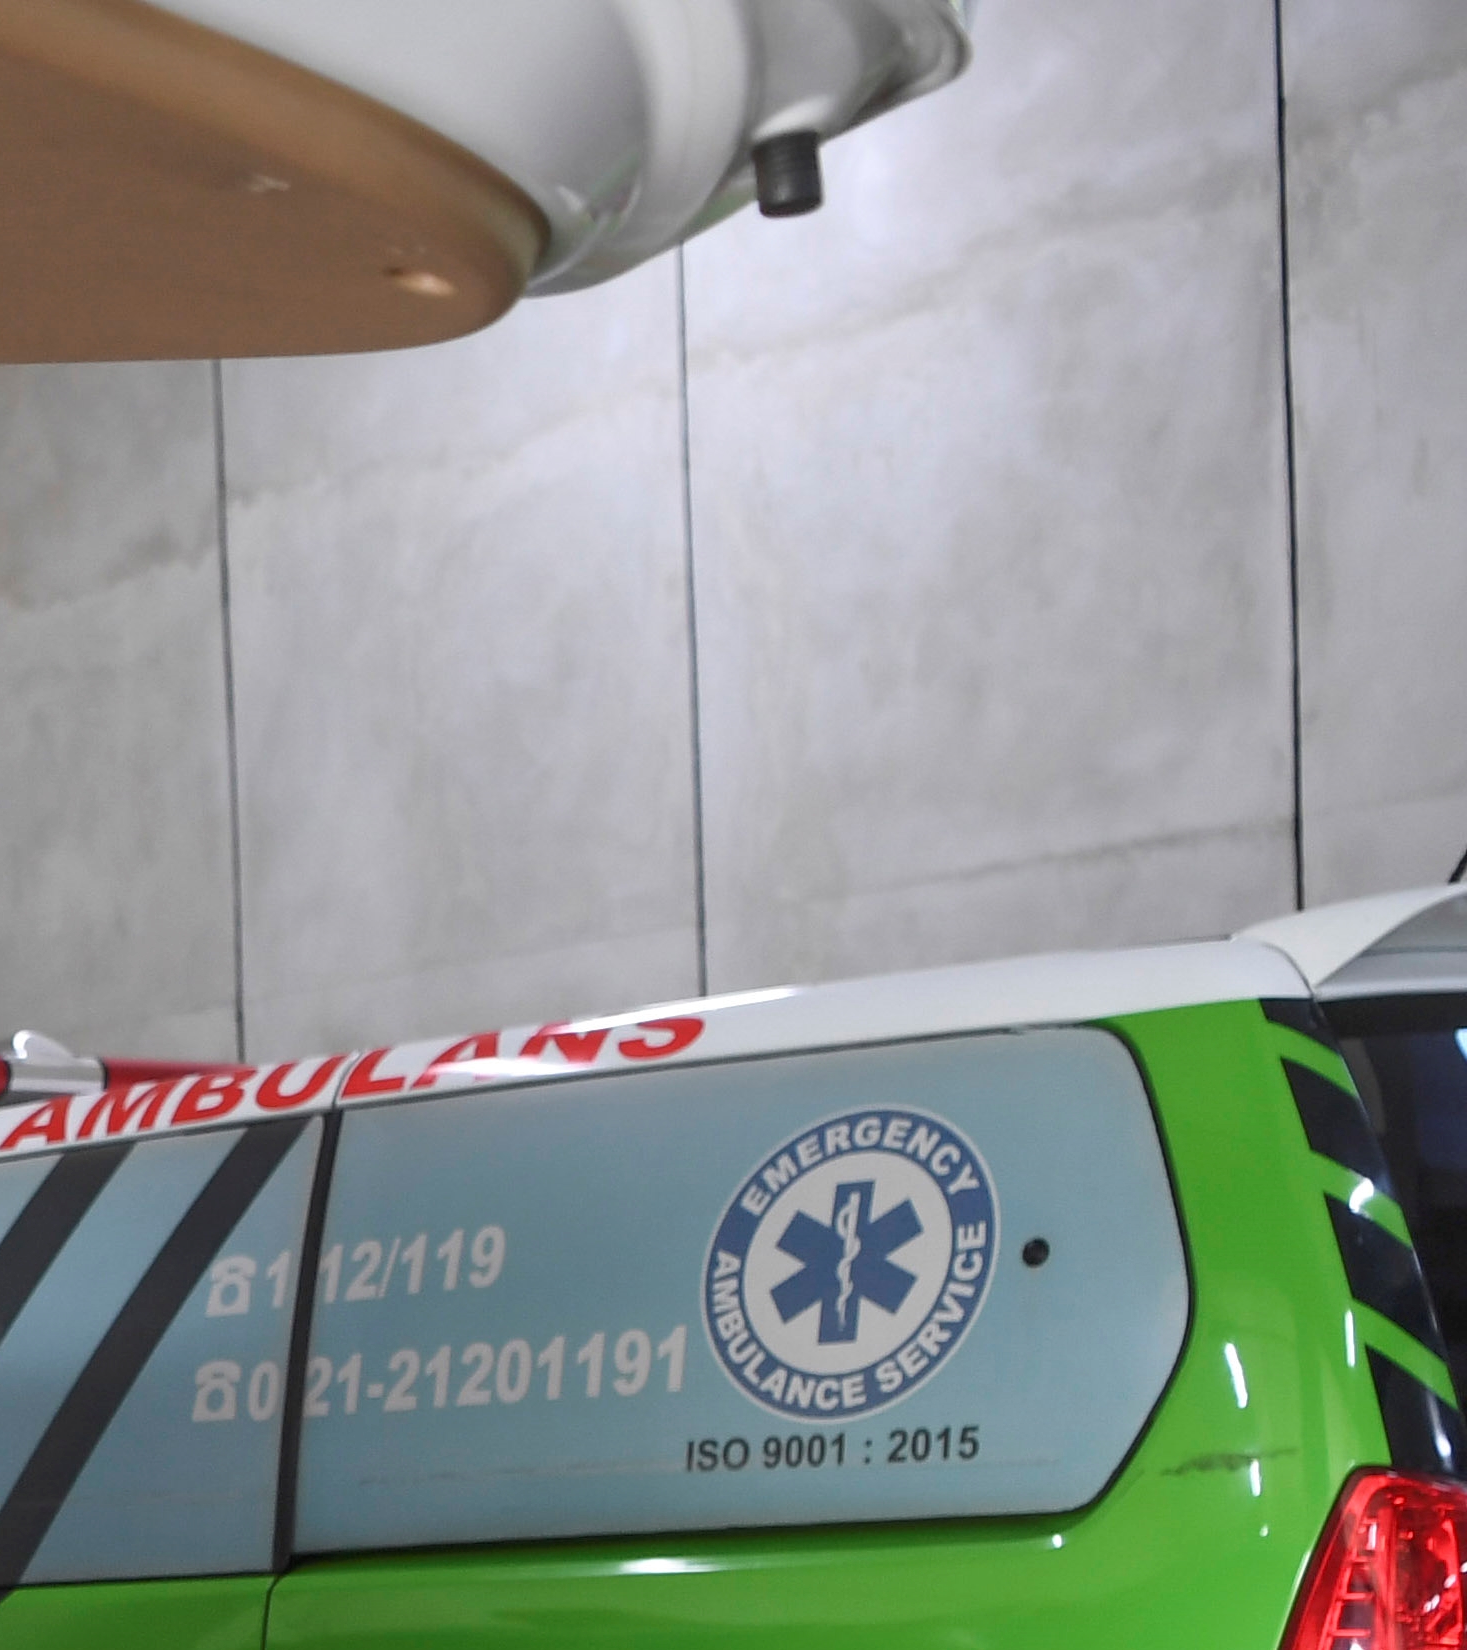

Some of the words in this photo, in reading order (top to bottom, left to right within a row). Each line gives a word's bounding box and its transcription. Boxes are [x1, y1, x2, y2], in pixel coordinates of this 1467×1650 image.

[741, 1115, 980, 1216] EMERGENCY
[713, 1250, 866, 1411] AMBULANCE
[874, 1221, 986, 1394] SERVICE
[247, 1325, 687, 1420] 021-21201191
[686, 1437, 749, 1472] ISO
[763, 1432, 846, 1467] 9001
[887, 1425, 980, 1464] 2015
